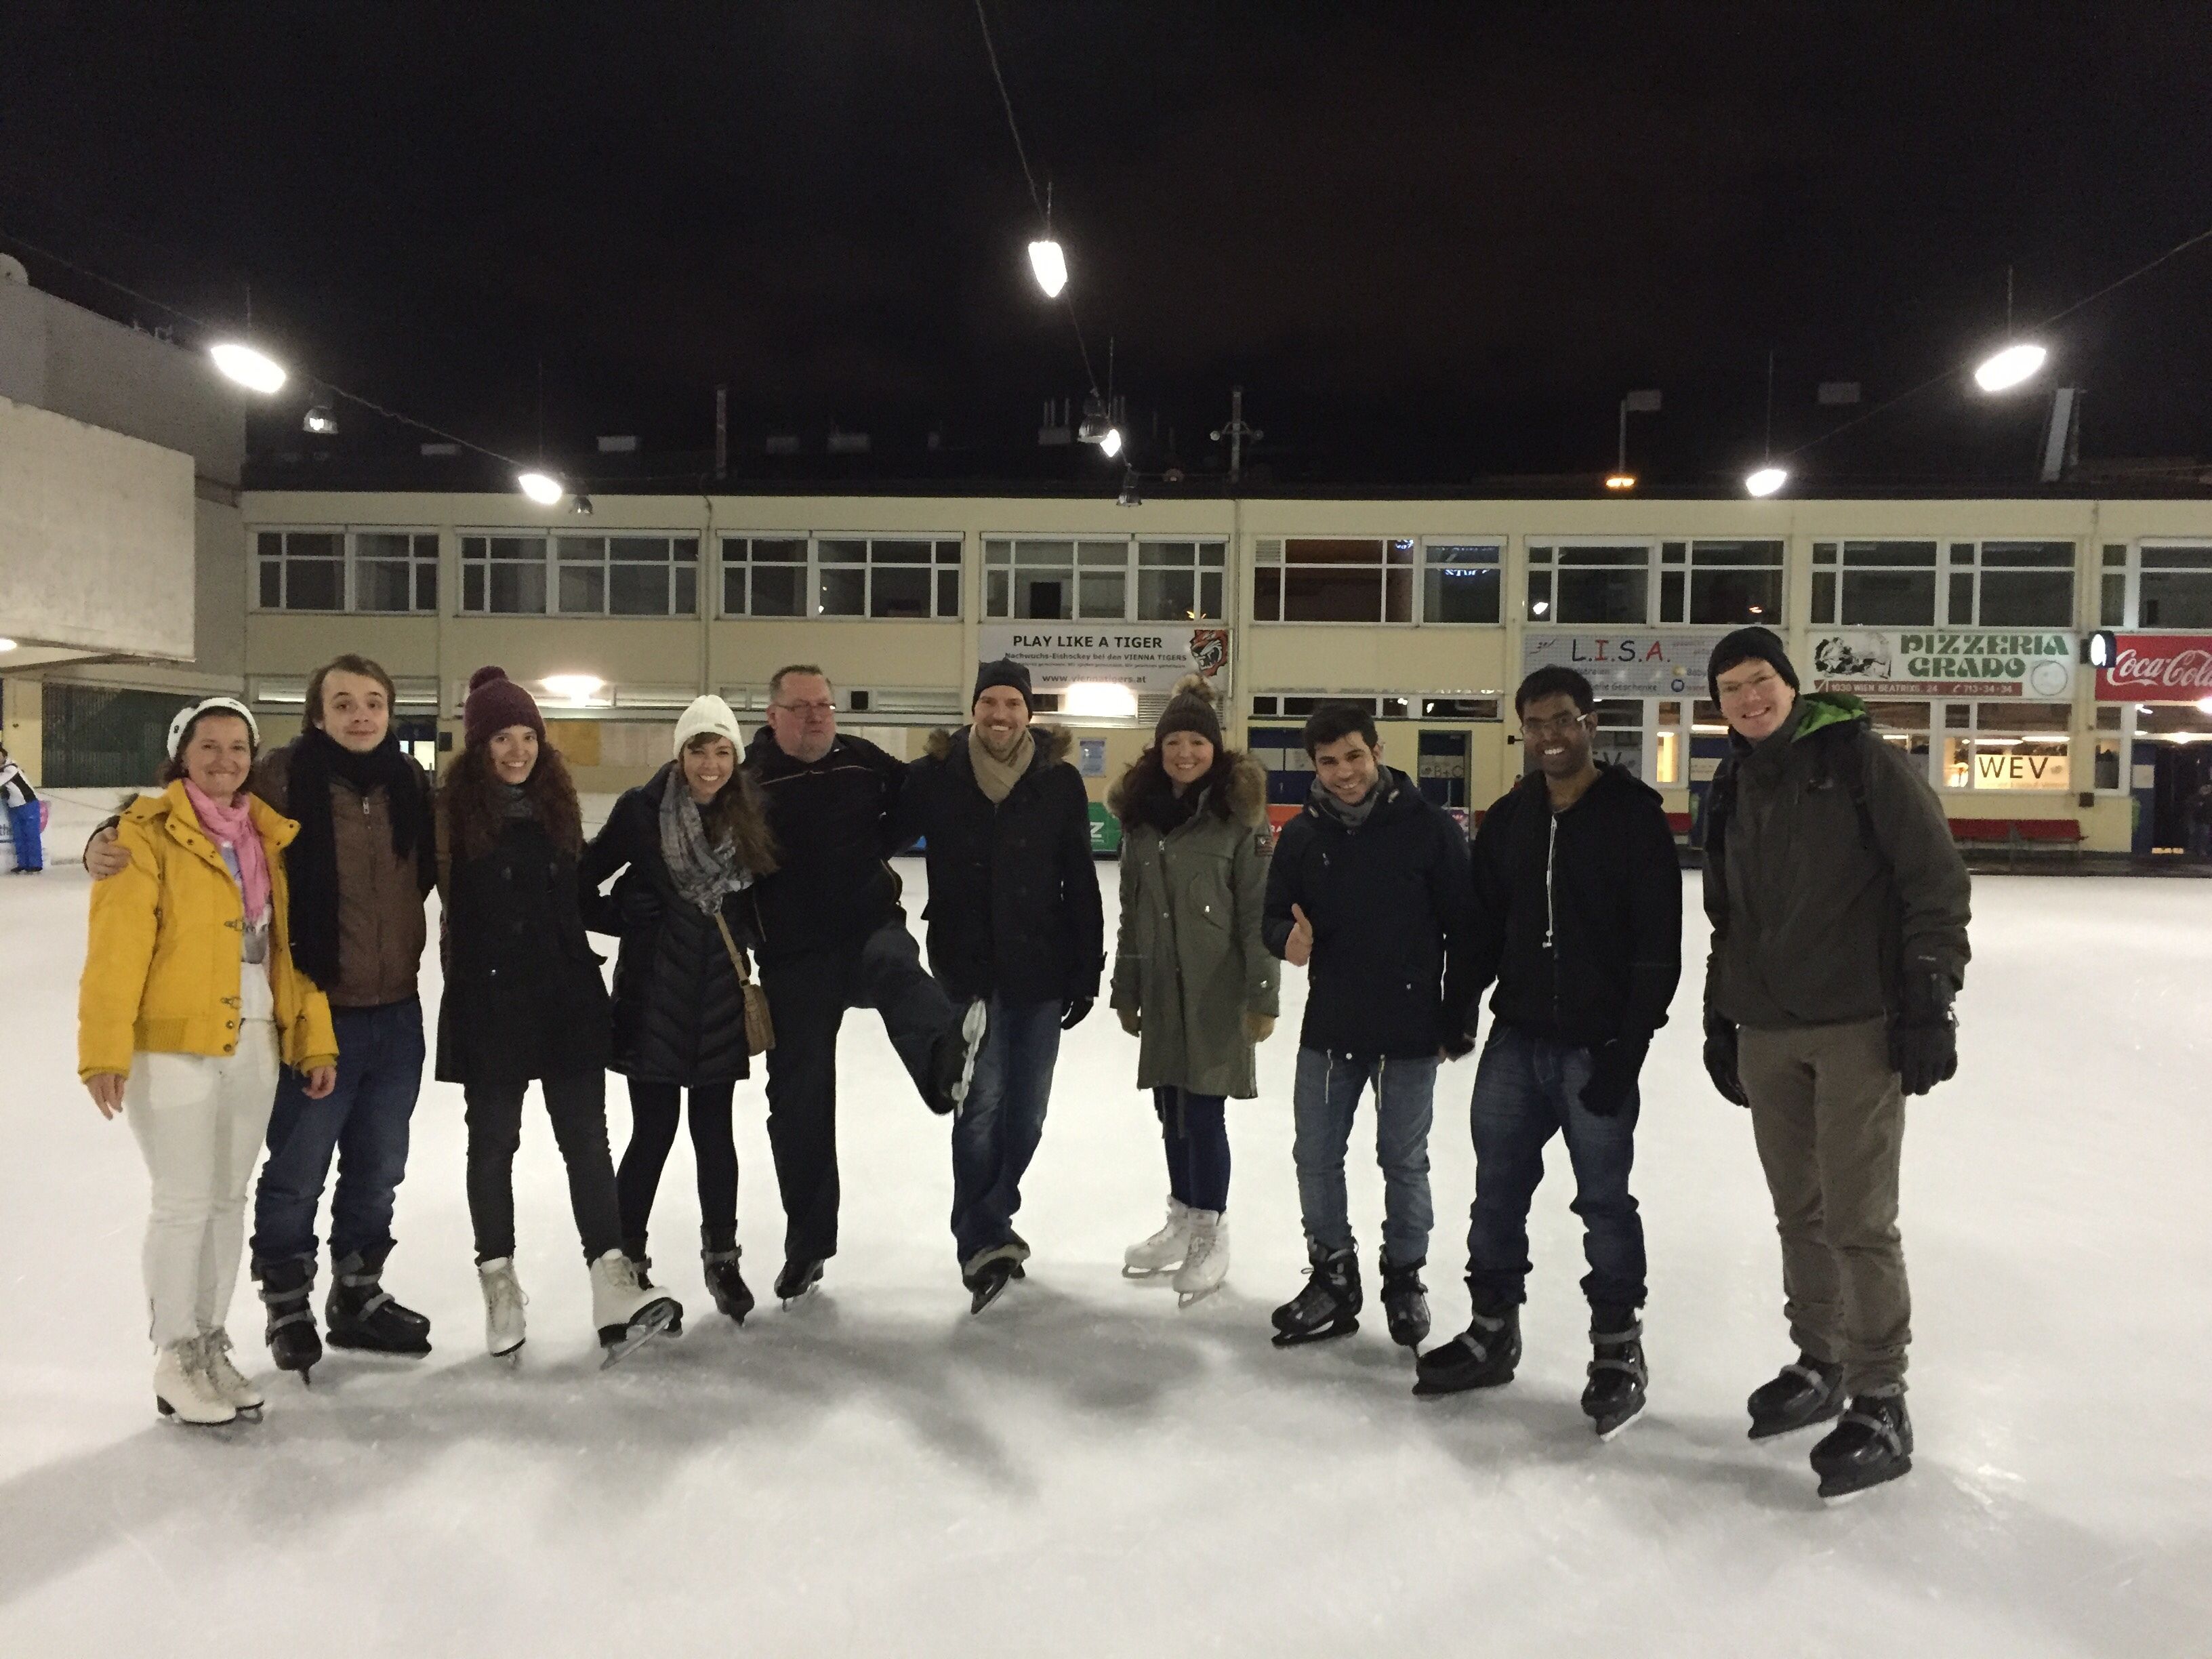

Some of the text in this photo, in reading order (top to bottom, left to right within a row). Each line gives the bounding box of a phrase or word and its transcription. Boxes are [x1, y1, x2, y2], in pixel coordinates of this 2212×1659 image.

[1013, 636, 1162, 648] PLAY LIKE A TIGER
[1572, 638, 1671, 662] L.I.S.A.
[1901, 634, 2069, 655] PIZZERIA
[1908, 657, 2026, 678] GRADO
[1854, 684, 1875, 692] WIEN
[1979, 756, 2049, 779] WEV
